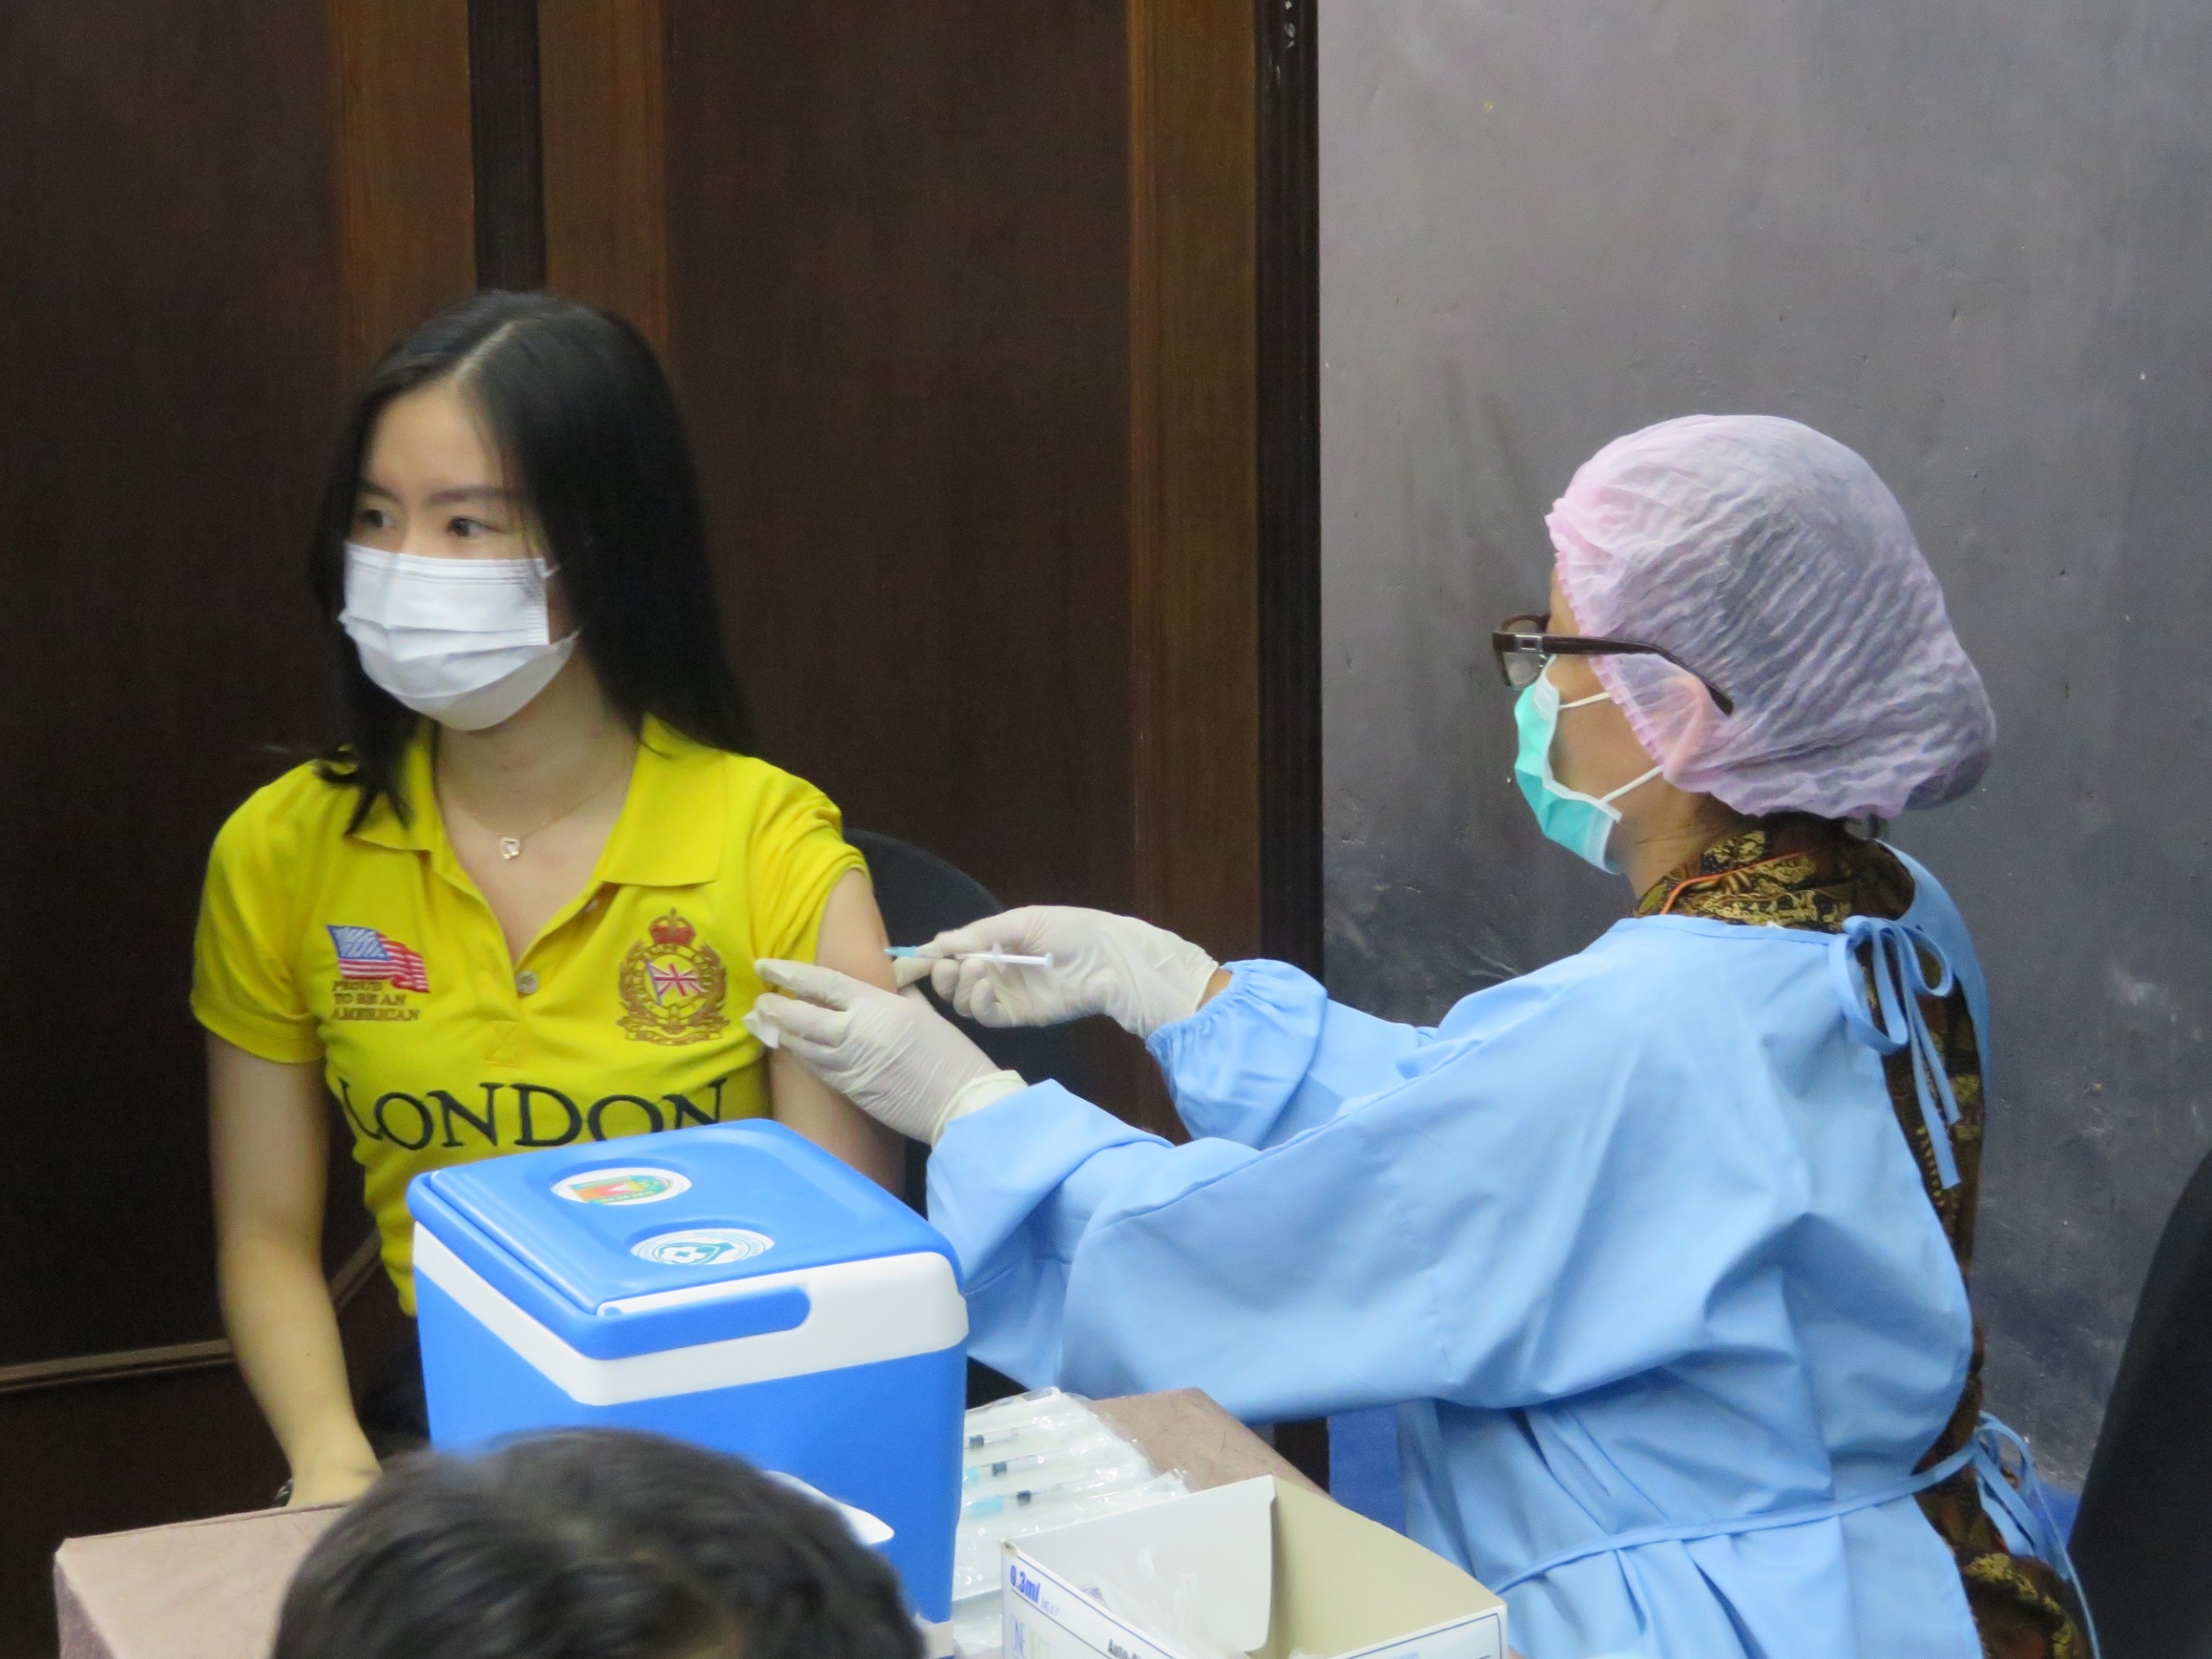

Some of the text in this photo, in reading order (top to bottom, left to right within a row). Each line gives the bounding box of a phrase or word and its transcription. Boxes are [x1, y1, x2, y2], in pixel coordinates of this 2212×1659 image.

[334, 993, 406, 1005] TO BE AN
[331, 1007, 421, 1021] AMERICAN
[340, 1077, 728, 1151] LONDON
